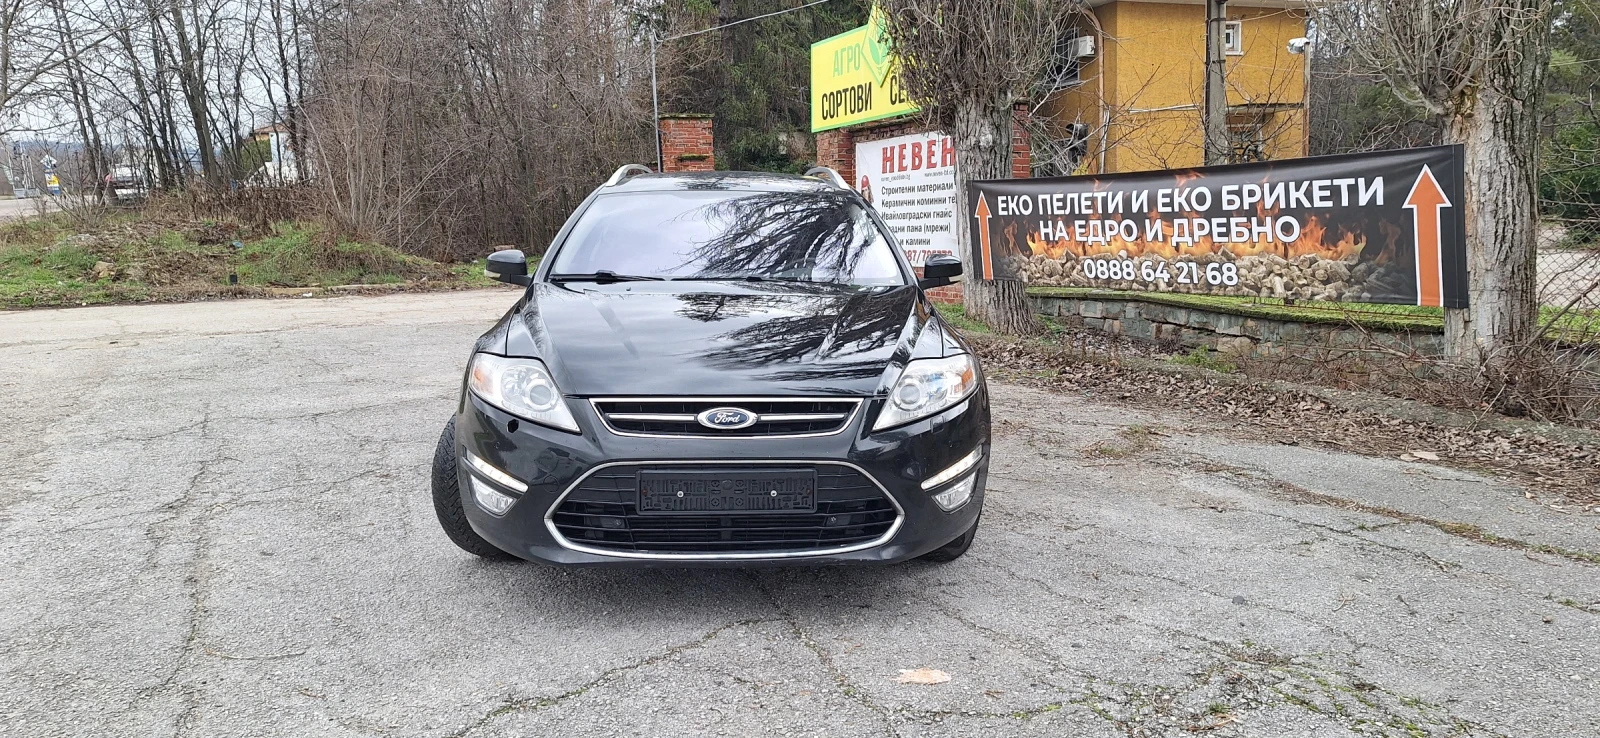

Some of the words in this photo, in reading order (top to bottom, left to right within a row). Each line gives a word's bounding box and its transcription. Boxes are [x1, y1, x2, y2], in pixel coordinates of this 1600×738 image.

[832, 43, 861, 77] АГРО
[821, 82, 872, 120] СОРТОВИ
[917, 182, 954, 194] материали
[997, 194, 1033, 216] ЕКО
[1038, 190, 1124, 216] ПЕЛЕТИ
[1131, 189, 1149, 214] И
[1157, 186, 1212, 213] ЕКО
[1221, 176, 1384, 212] БРИКЕТИ
[881, 198, 916, 209] Керамични
[933, 208, 953, 218] гнайс
[889, 225, 905, 233] адни
[907, 225, 922, 233] пана
[924, 222, 951, 234] (мрежи)
[1039, 220, 1070, 242] НА
[1074, 218, 1138, 246] ЕДРО
[1145, 218, 1163, 243] И
[1171, 215, 1300, 247] ДРЕБНО
[905, 238, 931, 246] камини
[1083, 258, 1136, 281] 0888
[1141, 260, 1171, 283] 64
[1177, 261, 1199, 284] 21
[1205, 262, 1238, 286] 68
[714, 412, 741, 424] Ford
